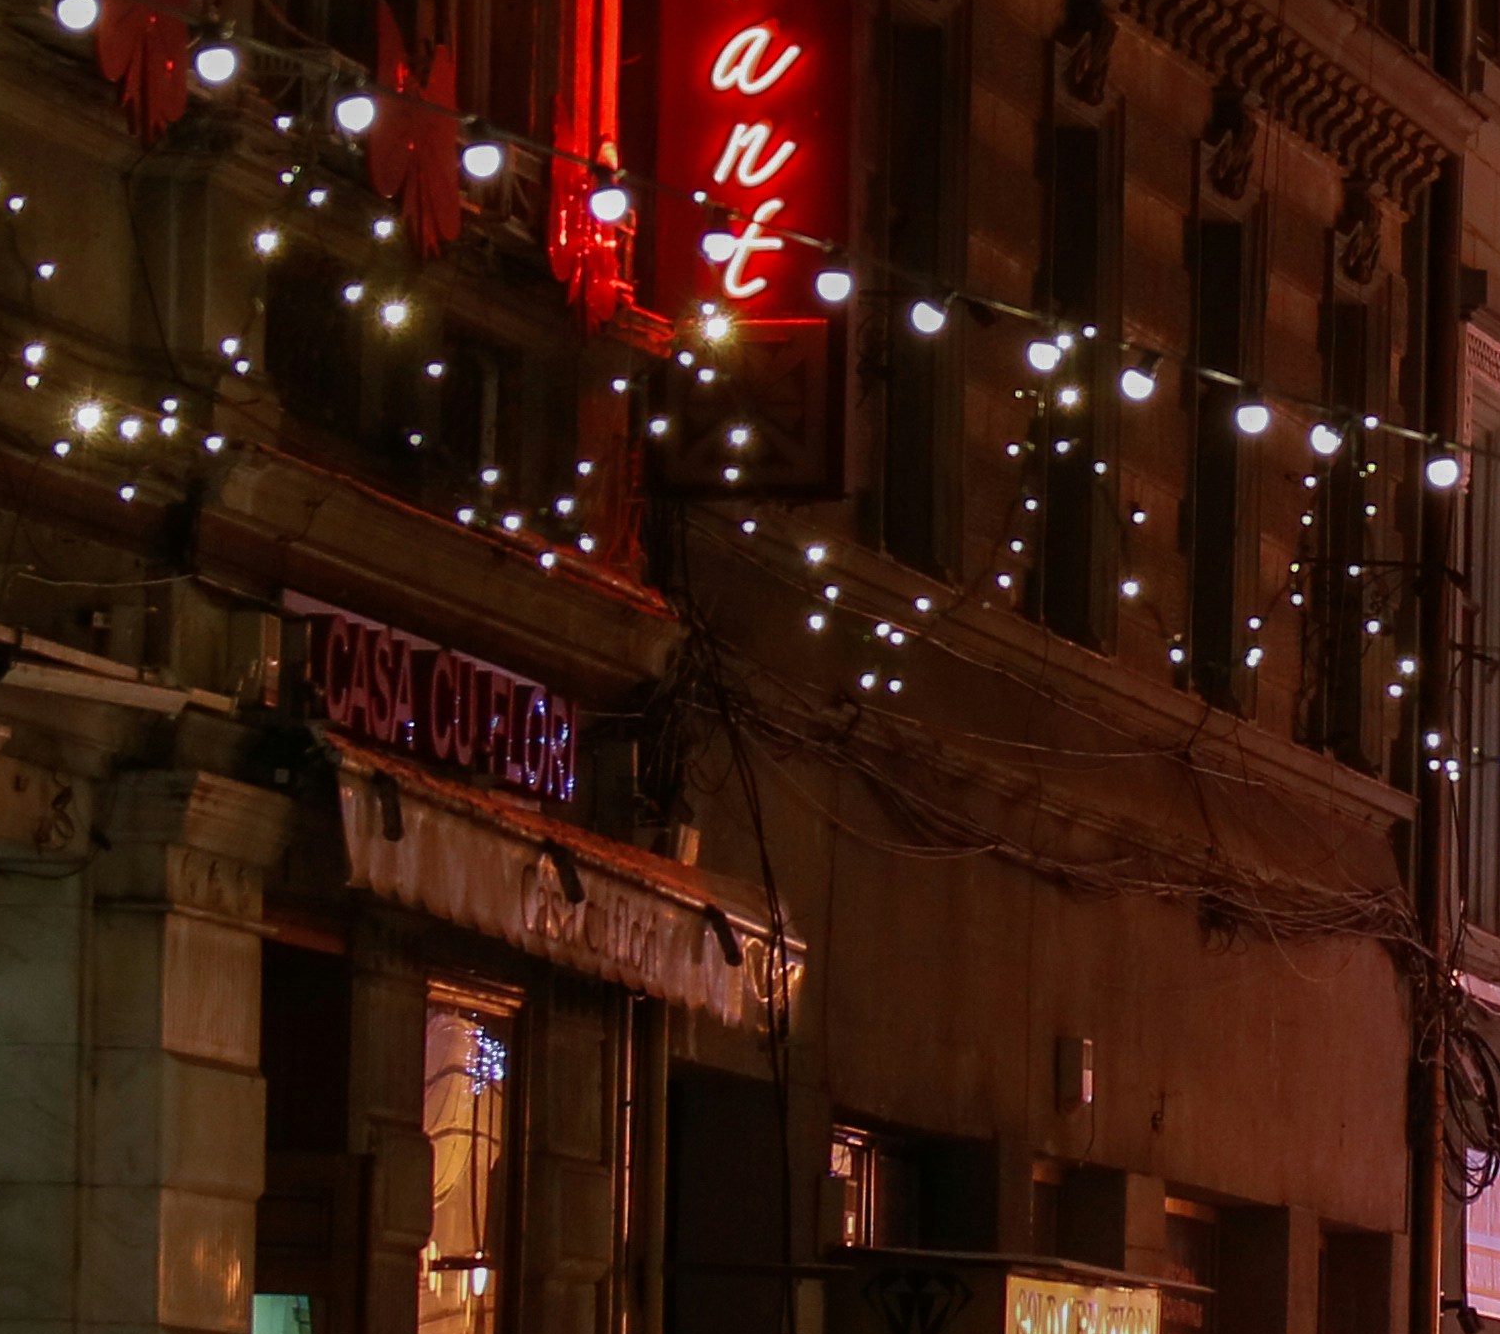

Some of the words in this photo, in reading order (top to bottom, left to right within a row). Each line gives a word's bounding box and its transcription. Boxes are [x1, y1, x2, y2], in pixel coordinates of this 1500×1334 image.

[326, 614, 415, 750] CASA
[430, 649, 476, 766] CU
[489, 670, 577, 804] FLORI
